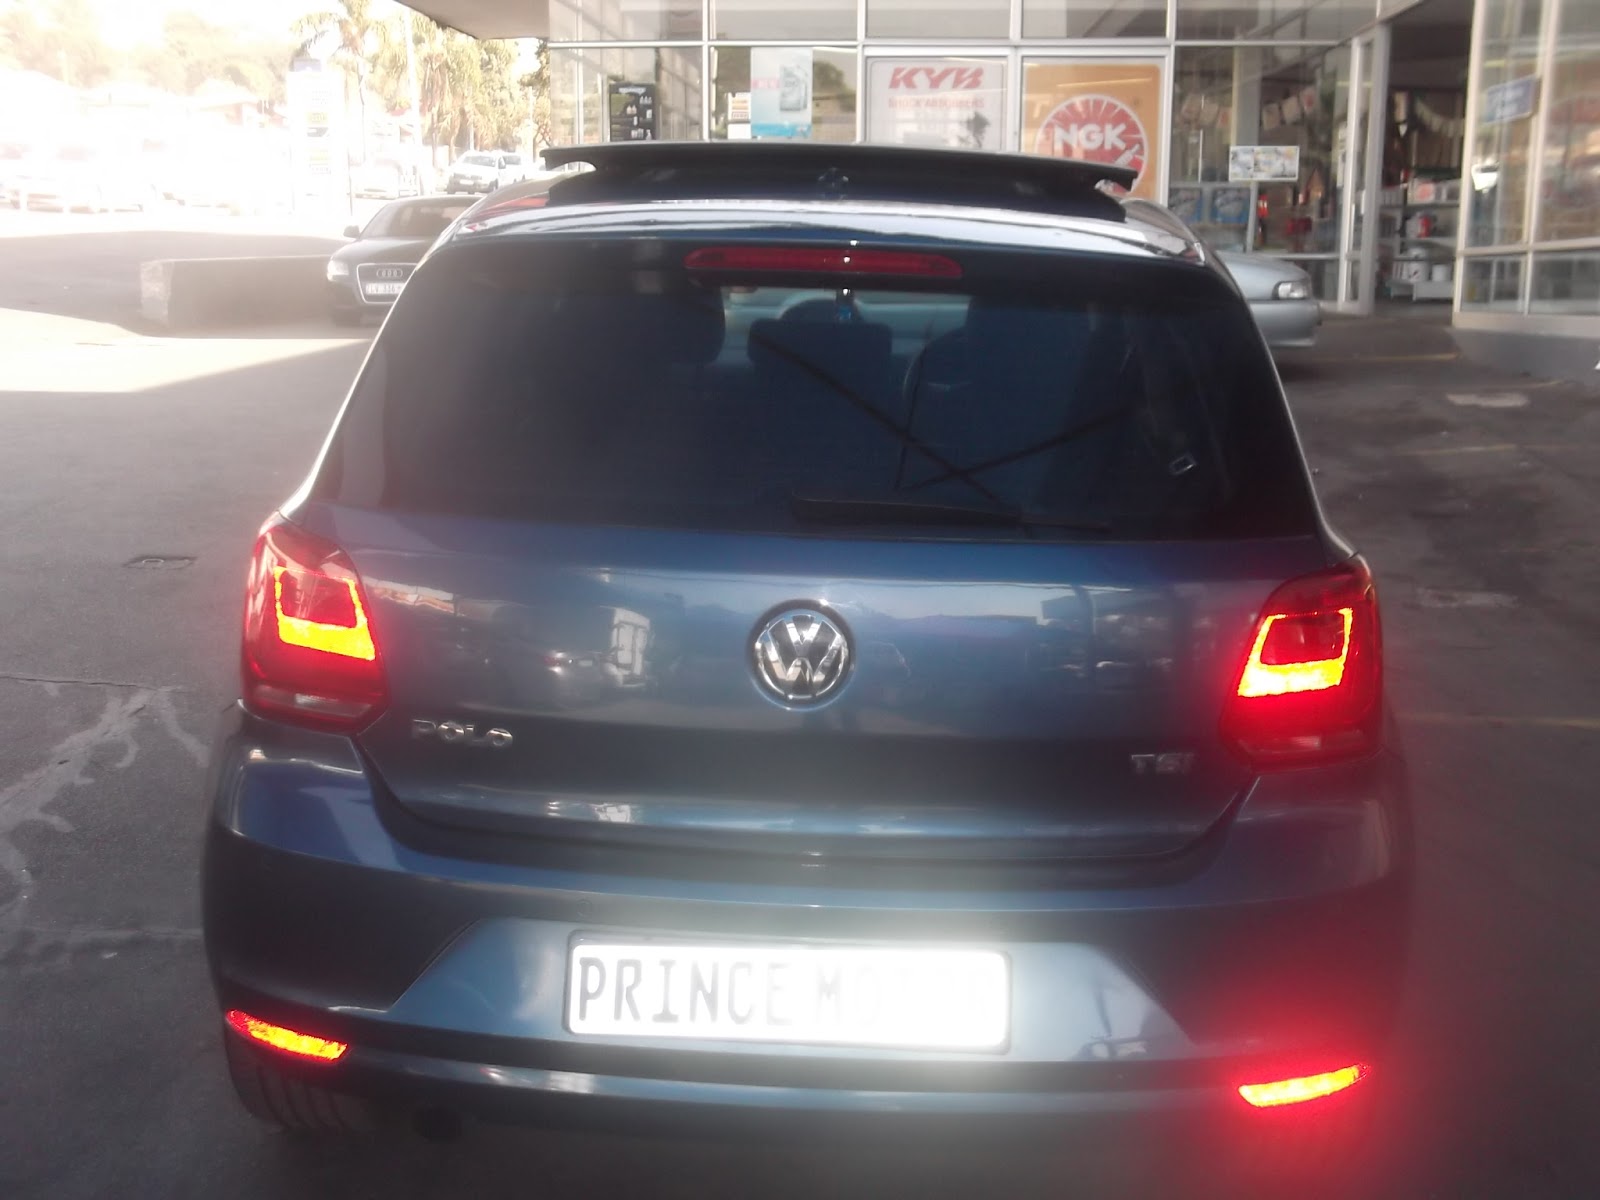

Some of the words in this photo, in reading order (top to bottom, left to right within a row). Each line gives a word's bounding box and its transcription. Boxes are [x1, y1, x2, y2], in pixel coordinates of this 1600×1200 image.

[888, 67, 984, 89] KYB
[1054, 123, 1127, 150] NGK
[411, 719, 513, 747] POLO
[578, 956, 793, 1026] PRINCE
